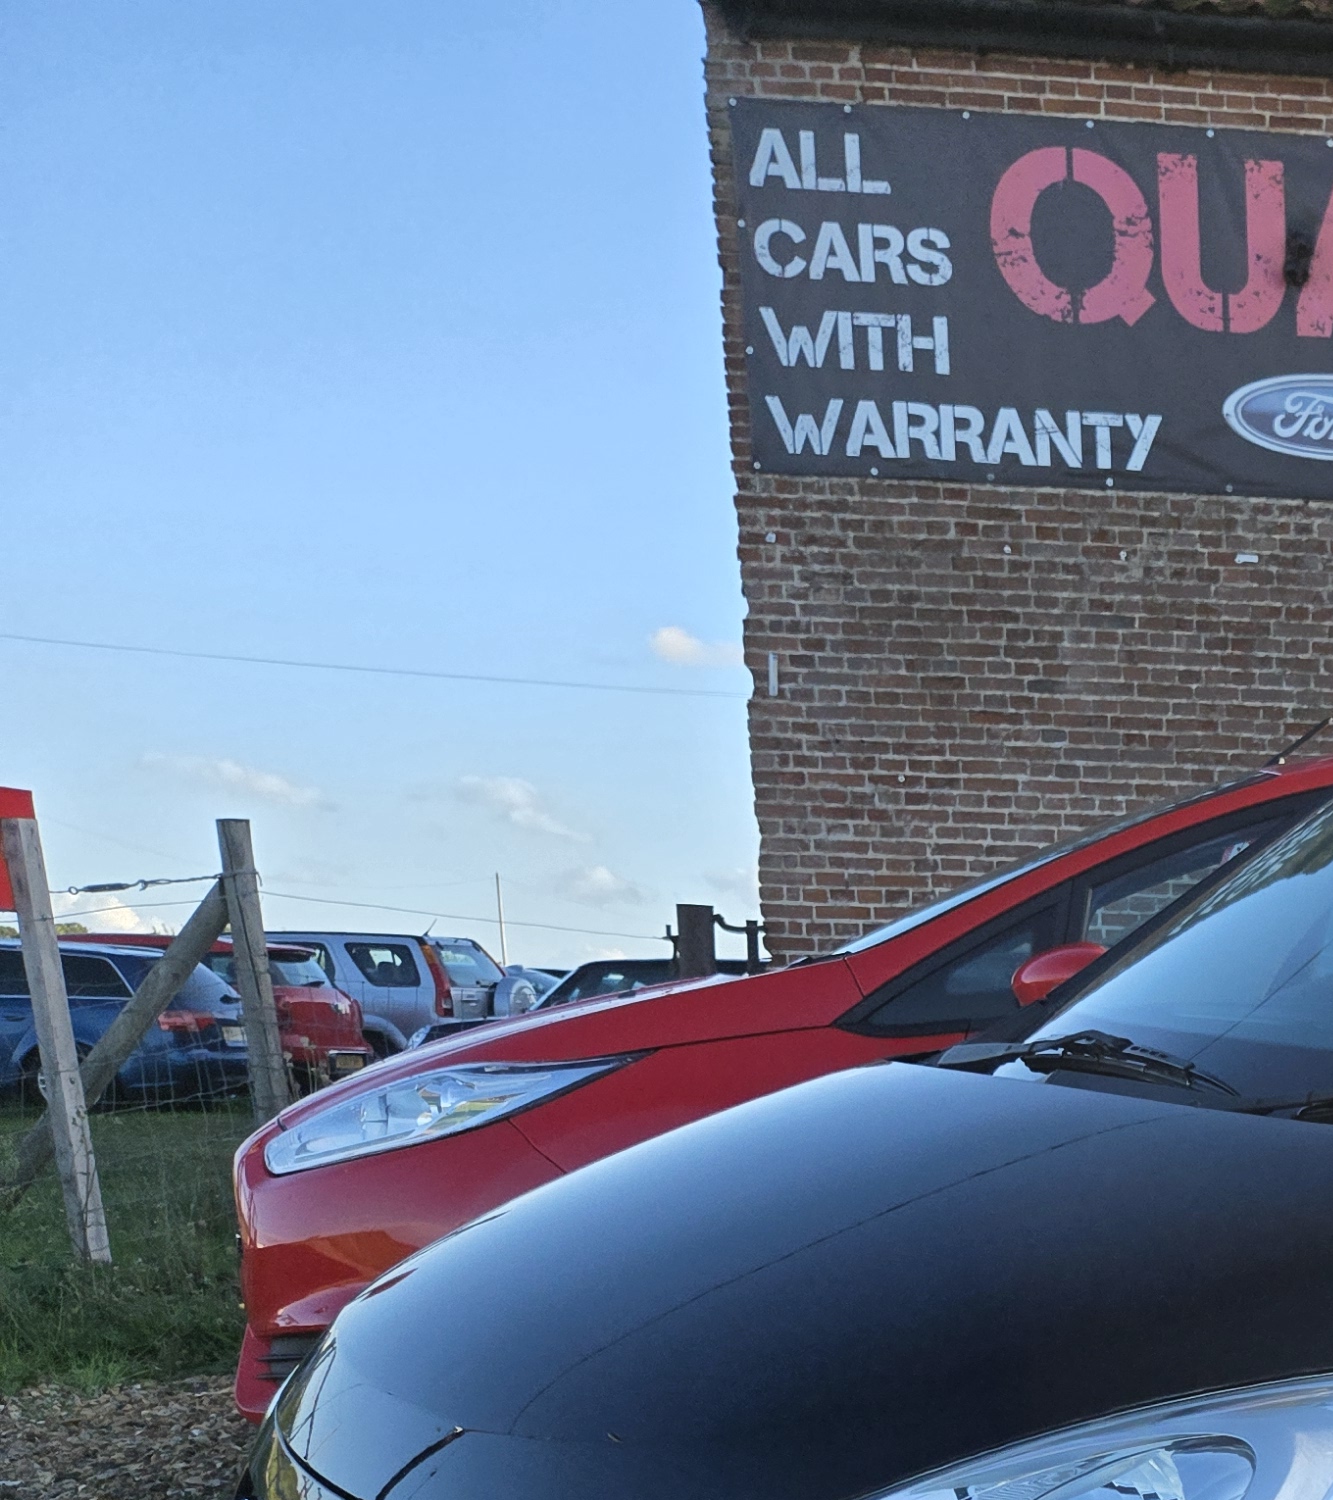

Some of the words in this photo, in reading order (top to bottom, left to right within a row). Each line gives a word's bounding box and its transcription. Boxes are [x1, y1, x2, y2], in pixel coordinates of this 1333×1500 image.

[749, 128, 891, 195] ALL
[752, 218, 953, 287] CARS
[759, 306, 950, 375] WITH
[765, 396, 1163, 471] WARRANTY
